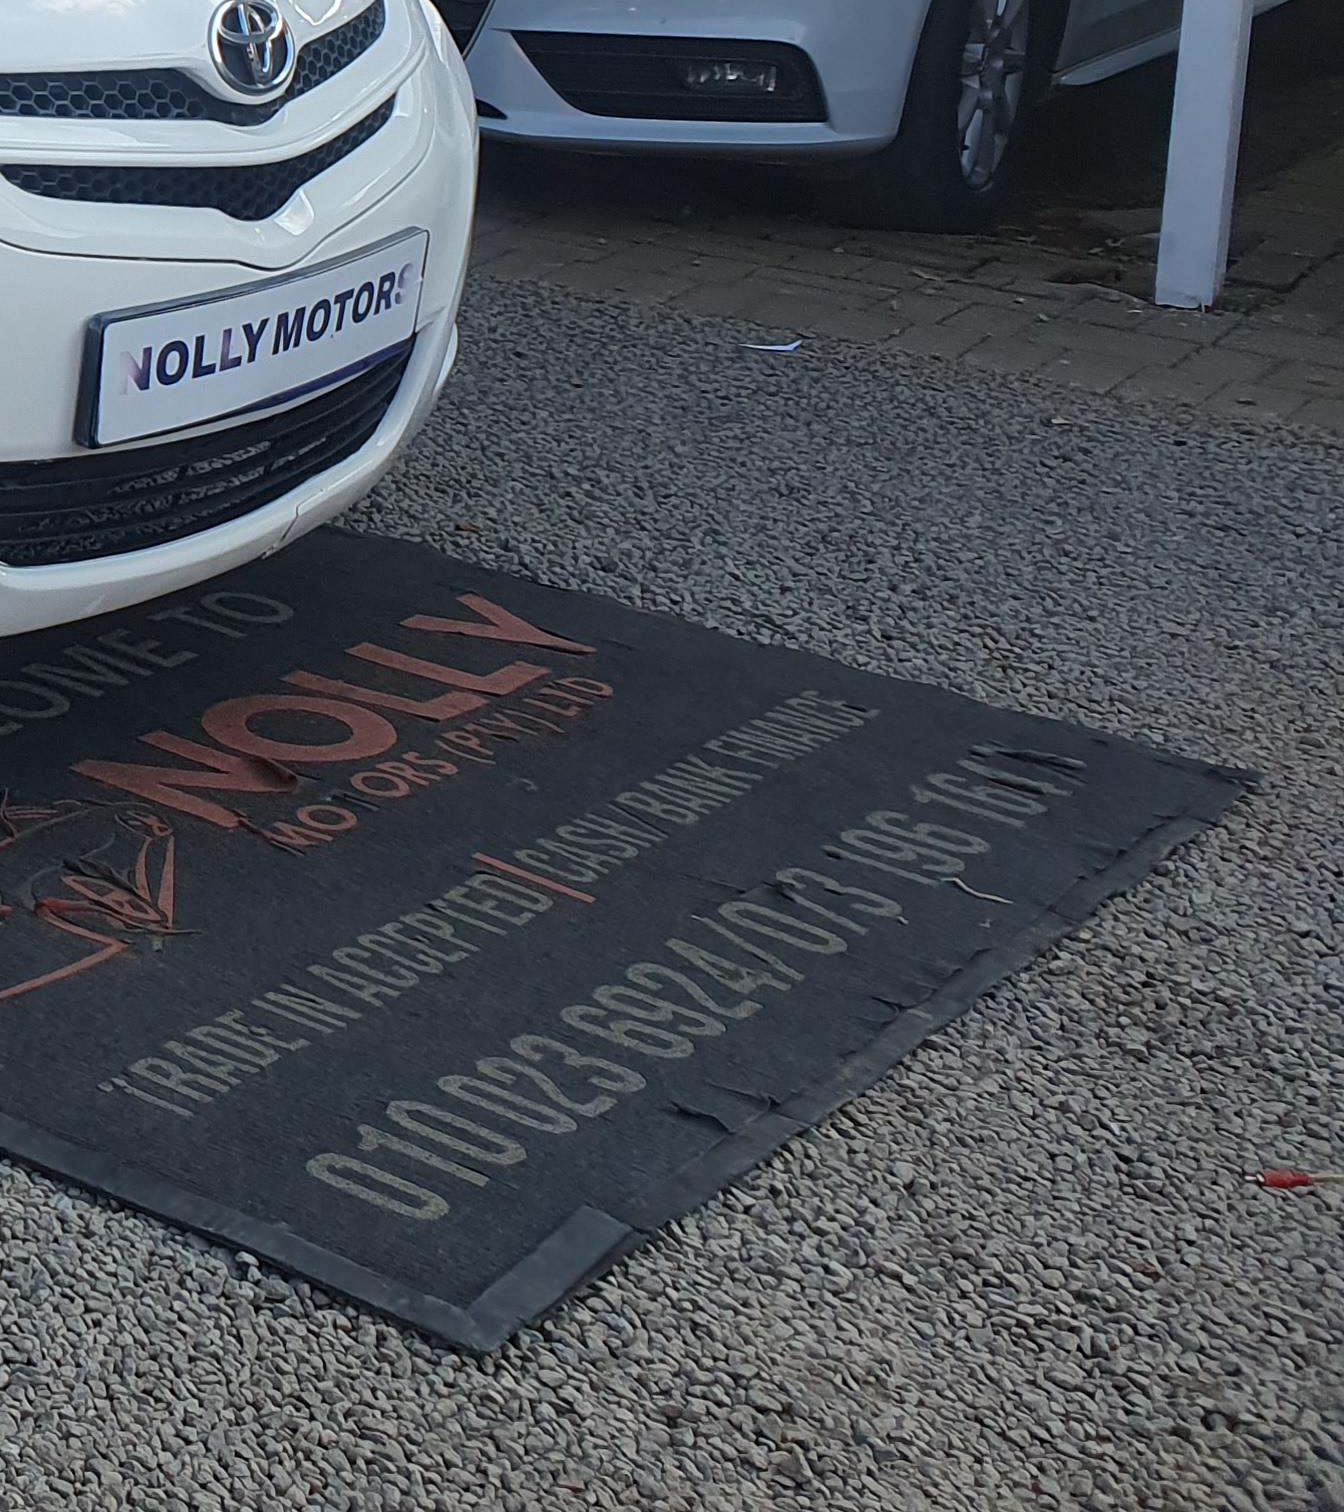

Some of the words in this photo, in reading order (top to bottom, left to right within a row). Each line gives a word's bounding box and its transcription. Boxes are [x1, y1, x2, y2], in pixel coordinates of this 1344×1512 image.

[118, 317, 271, 395] NOLLY
[270, 261, 415, 356] MOTORS
[152, 590, 295, 640] TO
[69, 592, 596, 829] NOLLY
[522, 675, 614, 717] LTD
[97, 1008, 311, 1119] TRADE
[251, 984, 363, 1034] IN
[703, 689, 882, 770] FINANCE
[305, 1098, 528, 1222] 010
[436, 1033, 648, 1135] 023
